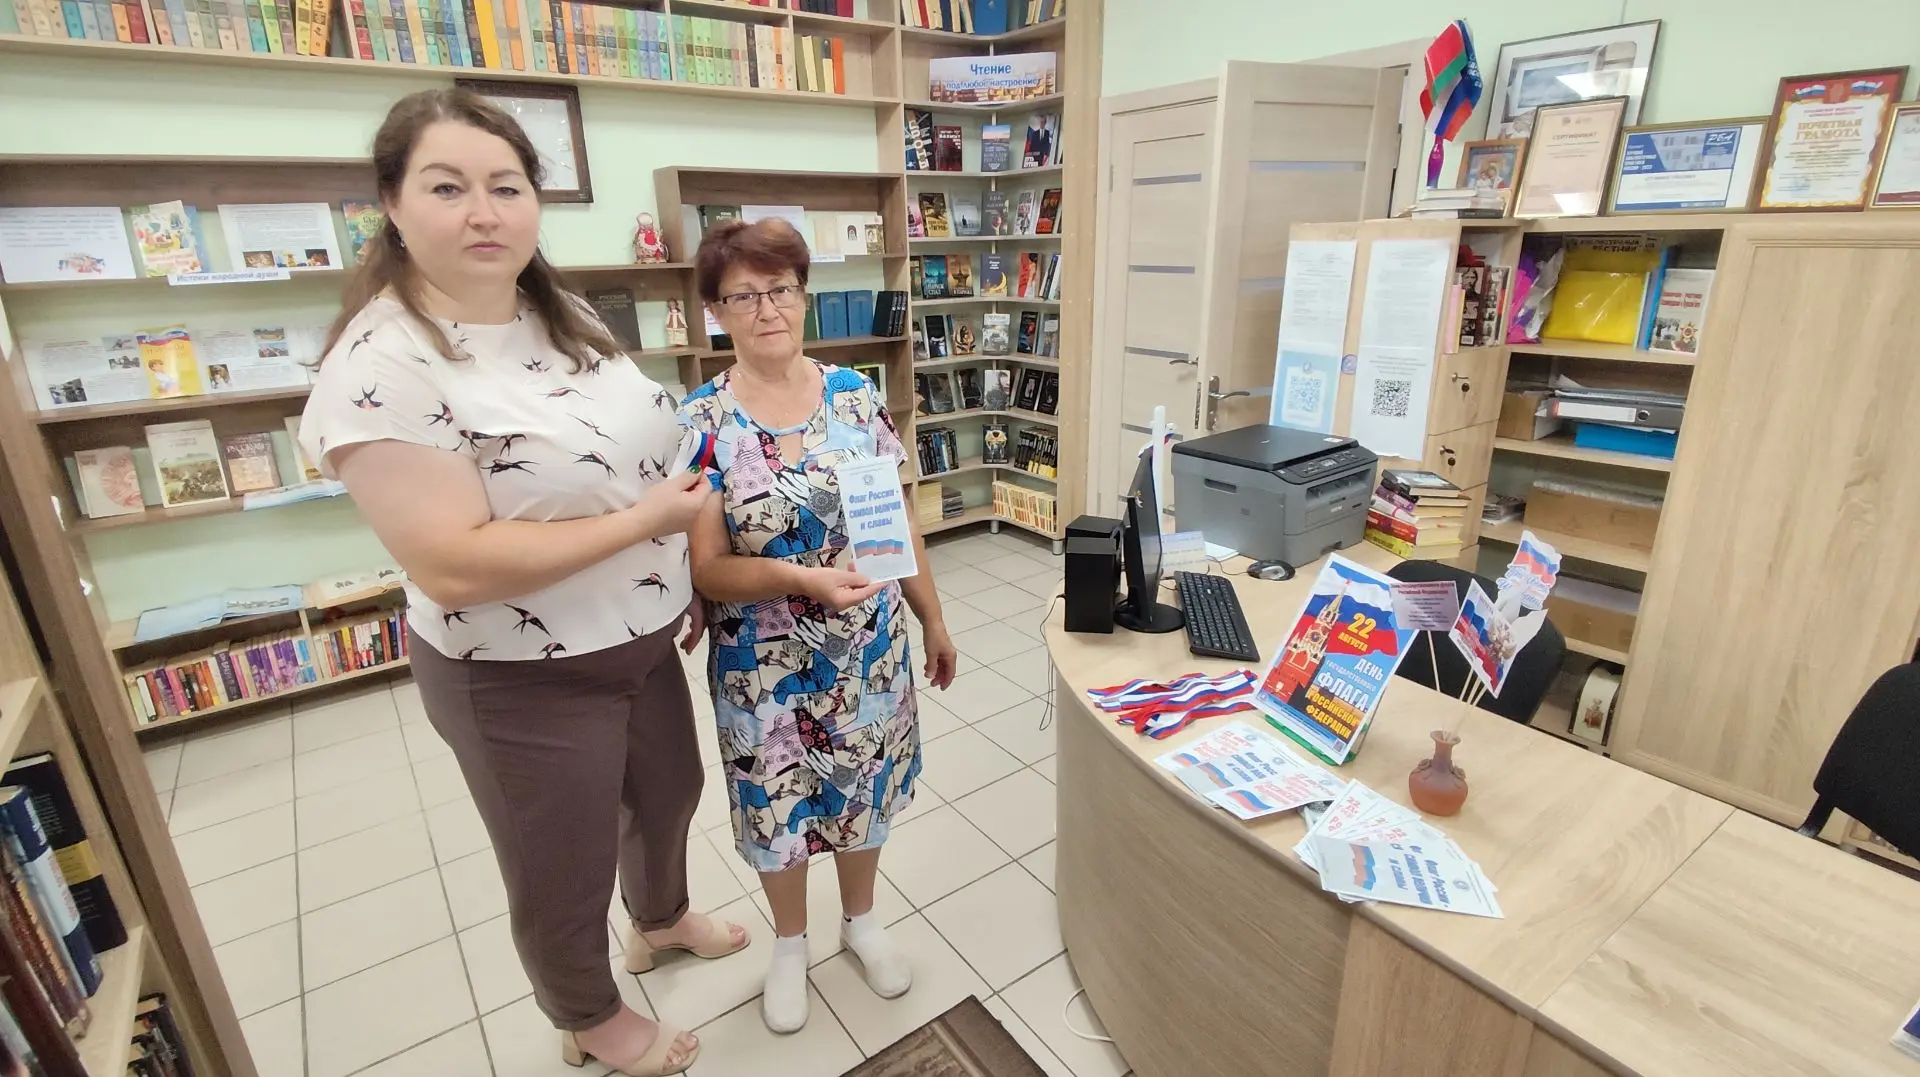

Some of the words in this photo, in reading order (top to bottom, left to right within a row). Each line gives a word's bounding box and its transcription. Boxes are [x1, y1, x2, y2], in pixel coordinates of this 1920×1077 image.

[970, 64, 1012, 75] Чтение
[946, 79, 960, 90] под
[961, 78, 988, 89] любое
[1552, 132, 1598, 140] СЕРТИФИКАТ
[1796, 128, 1860, 140] ГРАМОТА
[176, 272, 209, 283] Истоки
[211, 271, 254, 283] народной
[255, 270, 279, 282] души
[869, 489, 894, 501] России
[1347, 612, 1377, 638] 22
[1338, 632, 1369, 652] АВГУСТА
[1354, 658, 1384, 681] ДЕНЬ
[1318, 672, 1369, 712] ФЛАГА
[1307, 685, 1360, 727] РОССИЙСКОЙ
[1306, 703, 1353, 739] ФЕДЕРАЦИИ
